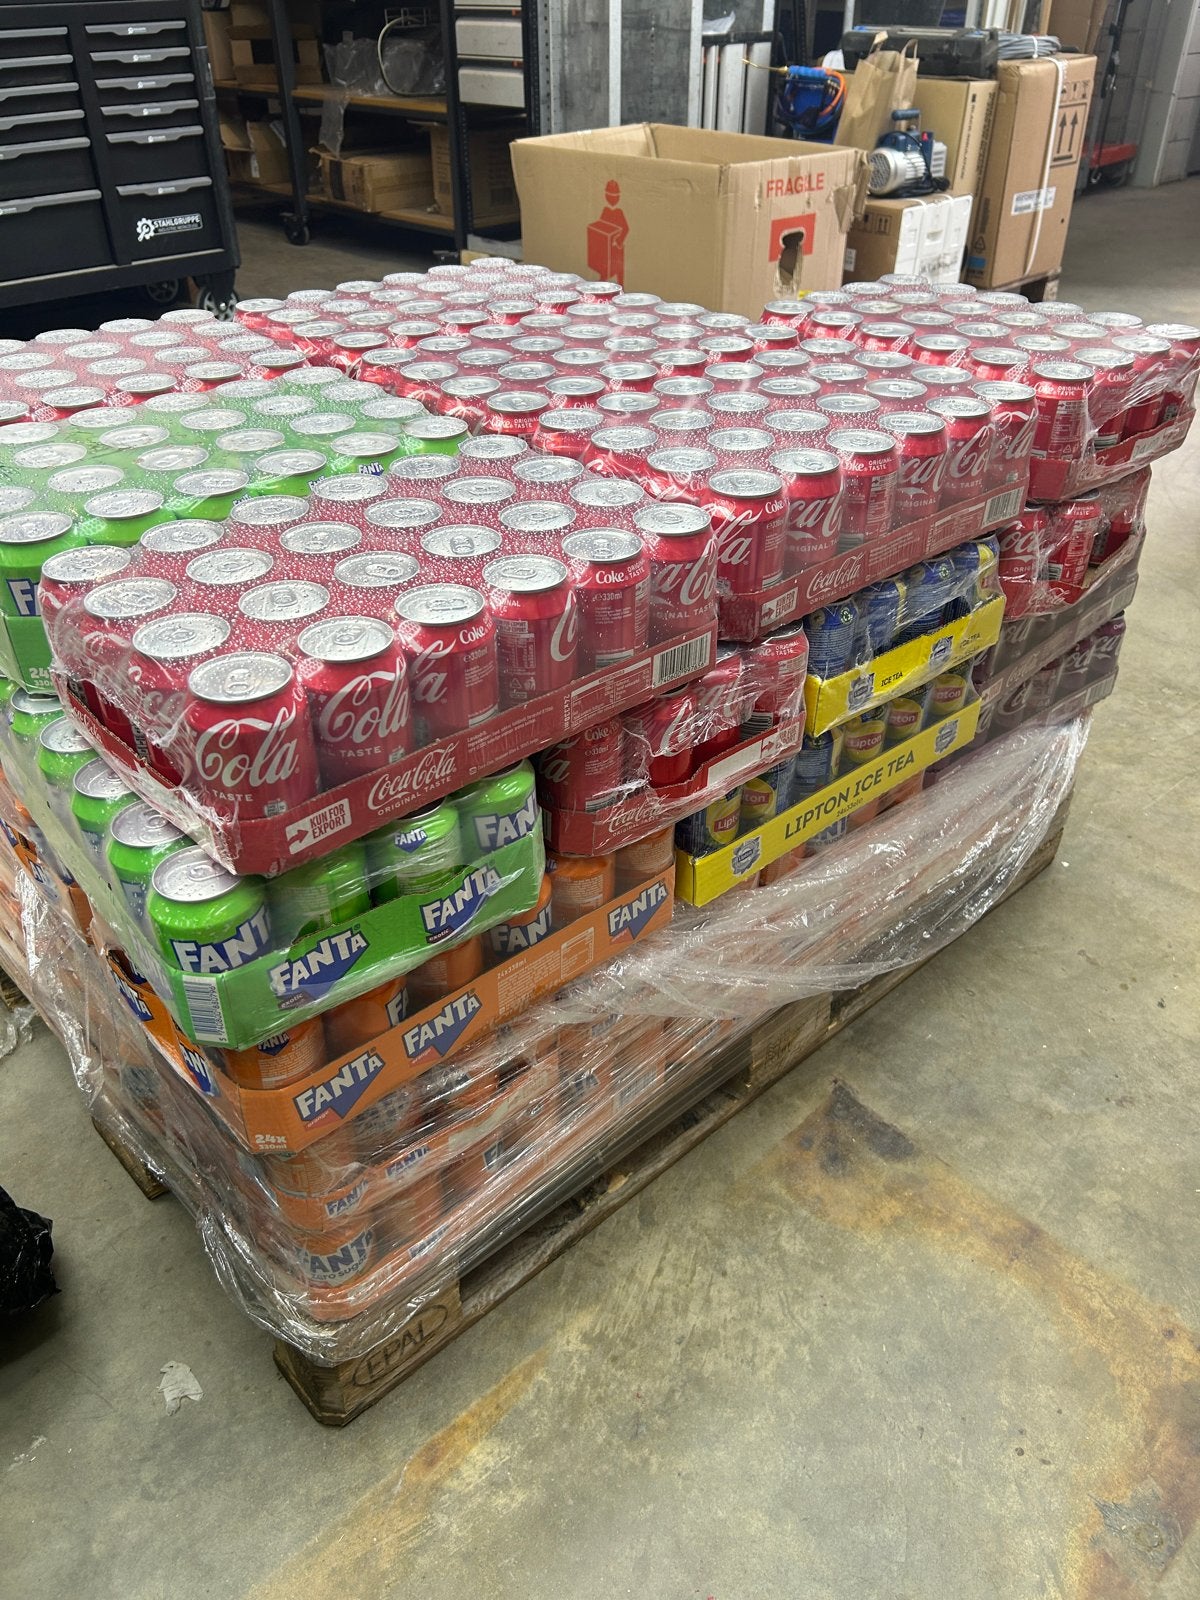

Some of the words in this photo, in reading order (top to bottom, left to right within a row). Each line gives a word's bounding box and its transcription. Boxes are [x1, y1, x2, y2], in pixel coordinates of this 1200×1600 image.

[766, 172, 825, 198] FRAGILE
[153, 215, 201, 228] STAHLGRUPPE
[358, 462, 385, 475] FANTA
[868, 464, 887, 472] TASTE
[765, 500, 784, 514] Coke
[595, 570, 625, 584] Coke
[459, 625, 486, 645] Coke
[196, 701, 300, 788] Cola
[340, 746, 382, 758] TASTE
[367, 741, 460, 811] Coca-Cola
[212, 789, 253, 802] TASTE
[377, 791, 422, 816] ORIGINAL
[424, 776, 453, 793] TASTE
[785, 787, 850, 840] LIPTON
[852, 768, 883, 798] ICE
[887, 750, 915, 778] TEA
[310, 812, 329, 828] KUN
[328, 804, 346, 818] FOR
[312, 814, 347, 839] EXPORT
[394, 828, 428, 845] FANTA
[422, 866, 501, 930] FANTA
[609, 881, 668, 934] FANTA
[172, 905, 272, 974] FANT
[269, 930, 368, 997] FANTA
[281, 993, 304, 1010] exotic
[403, 992, 480, 1055] FANTA
[295, 1053, 384, 1119] FANTA
[254, 1133, 287, 1144] 24x
[366, 1319, 437, 1379] EPAL
